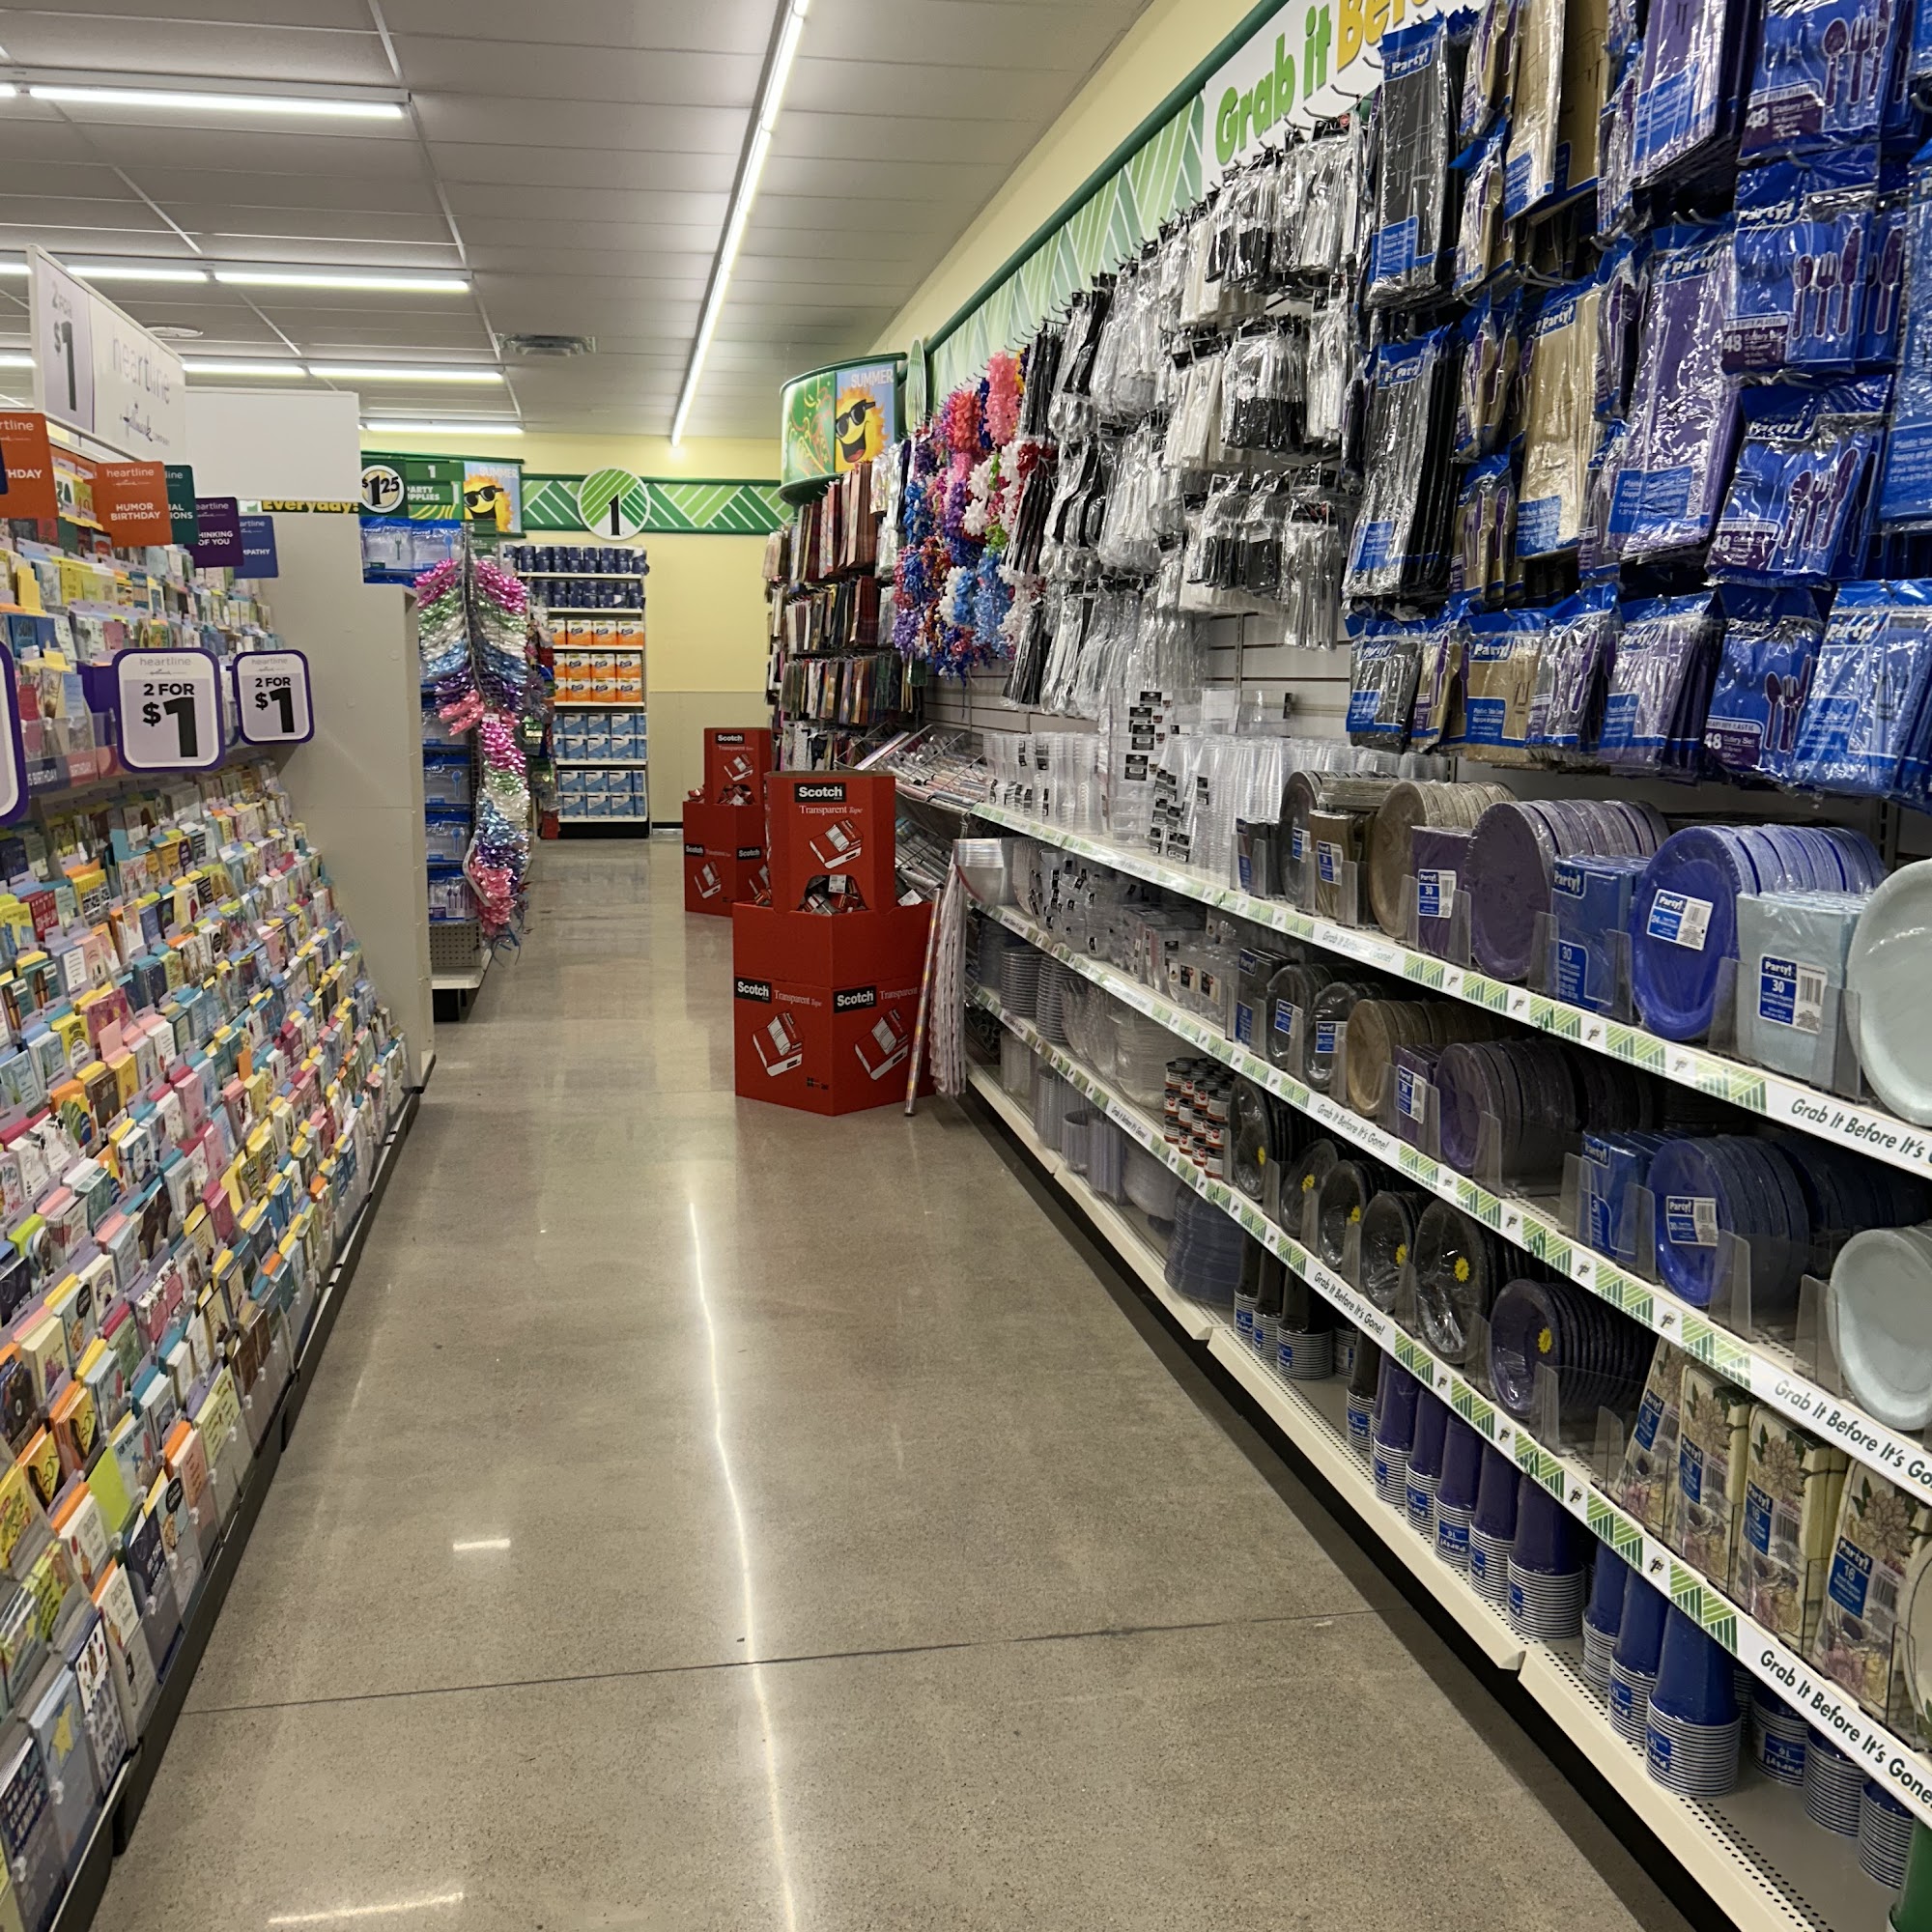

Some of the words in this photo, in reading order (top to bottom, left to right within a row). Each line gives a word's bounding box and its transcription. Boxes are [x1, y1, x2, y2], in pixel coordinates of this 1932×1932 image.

[1390, 47, 1430, 73] Party!
[1216, 33, 1295, 165] Grab
[1303, 4, 1332, 100] it
[1337, 0, 1429, 73] Be
[1746, 106, 1770, 128] 48
[1723, 333, 1742, 353] 48
[53, 320, 77, 412] $1
[850, 368, 895, 387] SUMMER
[106, 468, 155, 478] heartline
[428, 466, 437, 479] 1
[479, 467, 518, 478] SUMMER
[116, 502, 154, 511] HUMOR
[608, 494, 621, 536] 1
[111, 511, 161, 521] BIRTHDAY
[1712, 534, 1732, 553] 48
[139, 657, 191, 667] heartline
[251, 657, 288, 666] heartline
[143, 683, 155, 696] 2
[158, 683, 195, 696] FOR
[255, 678, 264, 688] 2
[266, 677, 291, 687] FOR
[255, 688, 296, 733] $1
[143, 696, 198, 757] $1
[717, 734, 743, 743] Scotch
[1704, 732, 1722, 750] 48
[798, 786, 843, 798] Scotch
[799, 805, 848, 816] Transparent
[738, 848, 760, 858] Scotch
[1424, 885, 1434, 895] 30
[1553, 870, 1580, 893] Party!
[1659, 895, 1684, 911] Party!
[1561, 947, 1572, 961] 30
[1764, 960, 1793, 978] Party!
[737, 980, 770, 998] Scotch
[773, 989, 810, 1006] Transparent
[1772, 979, 1785, 994] 30
[837, 990, 874, 1008] Scotch
[879, 986, 918, 1001] Transparent
[1317, 1103, 1333, 1120] Grab
[1338, 1115, 1359, 1134] Before
[1357, 1125, 1369, 1140] It's
[1367, 1132, 1390, 1151] Gone!
[1791, 1097, 1829, 1124] Grab
[1829, 1111, 1844, 1129] It
[1844, 1117, 1898, 1149] Before
[1899, 1135, 1926, 1159] It's
[1584, 1142, 1607, 1161] Party!
[1668, 1201, 1692, 1214] Party!
[1315, 1271, 1331, 1291] Grab
[1328, 1283, 1336, 1295] It
[1334, 1288, 1355, 1312] Before
[1353, 1303, 1365, 1320] It's
[1363, 1313, 1386, 1336] Gone!
[1775, 1379, 1812, 1411] Grab
[1812, 1401, 1827, 1420] It
[1826, 1409, 1879, 1452] Before
[1879, 1442, 1906, 1468] It's
[1907, 1459, 1932, 1489] Go
[1747, 1483, 1771, 1510] Party!
[1751, 1505, 1761, 1520] 16
[1838, 1538, 1870, 1572] Party!
[1843, 1563, 1856, 1581] 16
[1760, 1649, 1796, 1688] Grab
[1796, 1679, 1811, 1700] It
[1810, 1690, 1861, 1743] Before
[1861, 1734, 1888, 1765] It's
[1766, 1754, 1804, 1776] Party!
